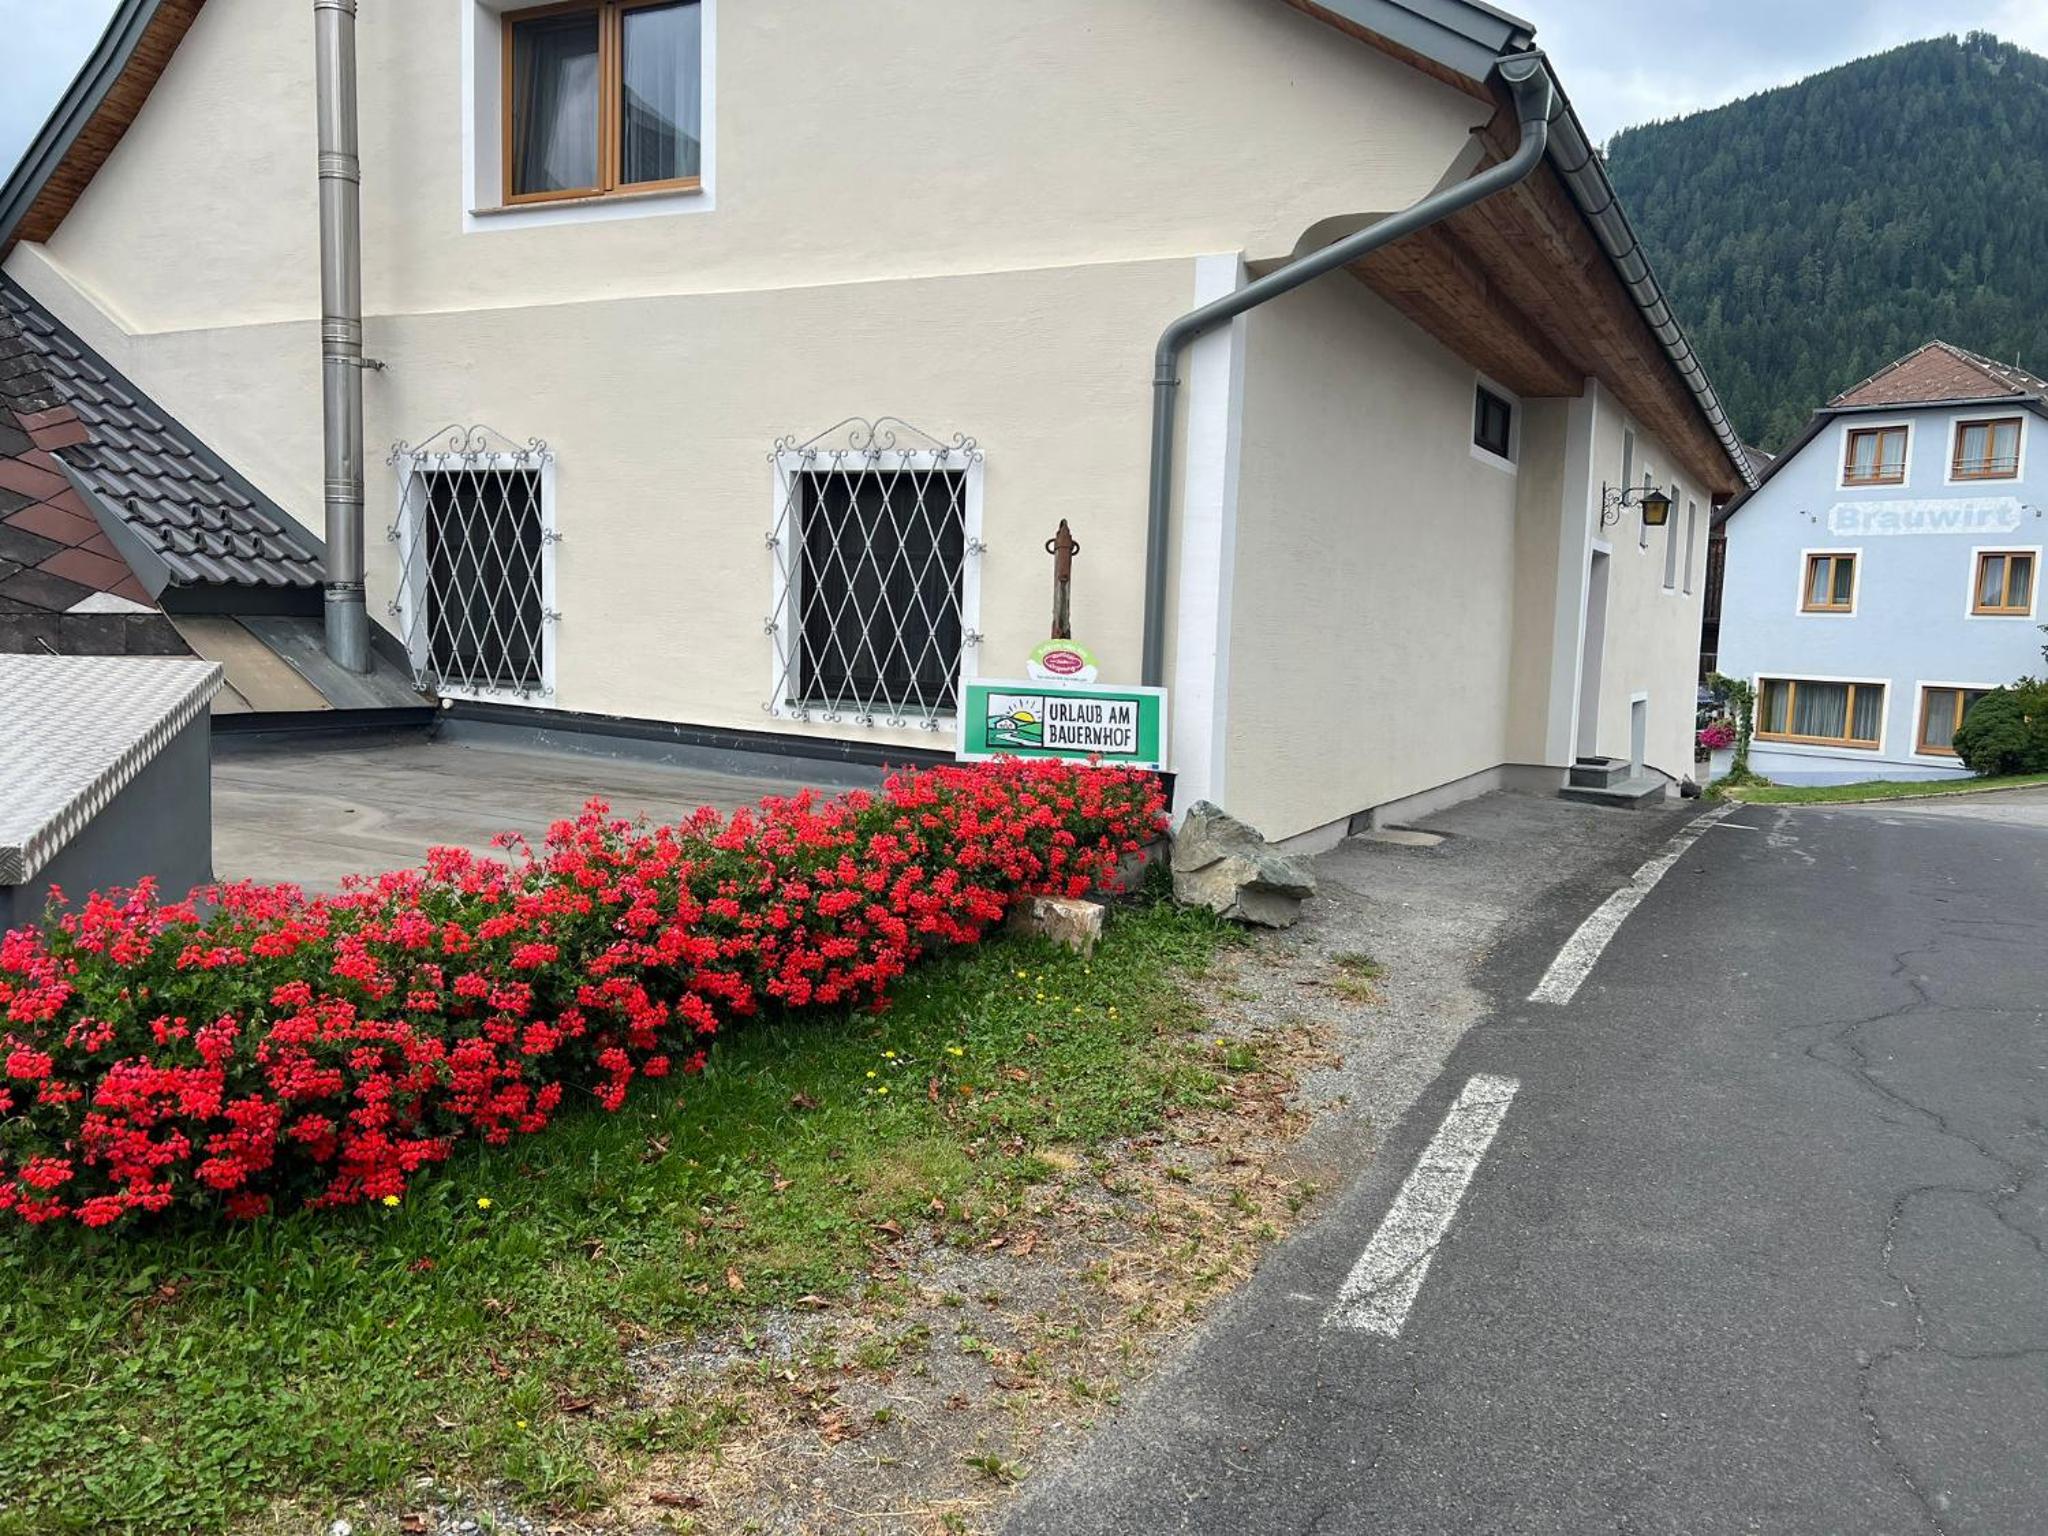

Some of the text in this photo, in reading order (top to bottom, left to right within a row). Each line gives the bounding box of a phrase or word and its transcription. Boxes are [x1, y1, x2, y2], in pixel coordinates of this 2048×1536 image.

[1837, 503, 2013, 530] Brauwirt
[1049, 703, 1130, 724] URLAUB AM
[1049, 724, 1131, 746] BAUERNHOF
